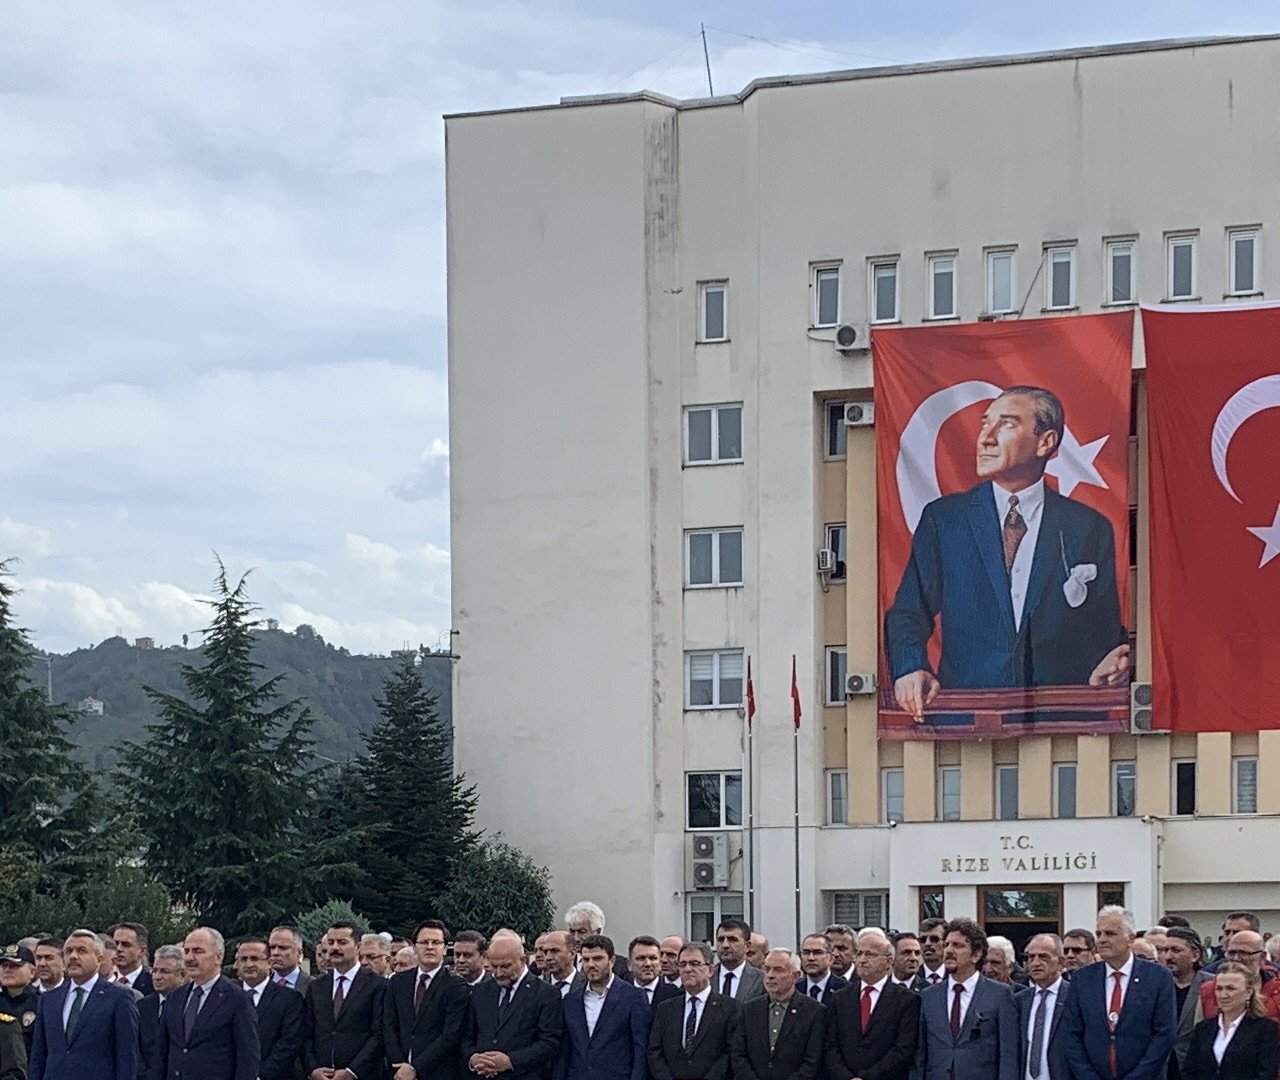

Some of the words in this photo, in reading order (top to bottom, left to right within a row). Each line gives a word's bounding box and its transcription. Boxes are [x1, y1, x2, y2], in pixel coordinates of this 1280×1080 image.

[999, 836, 1034, 850] T.C.
[941, 854, 989, 872] RİZE
[1002, 851, 1098, 872] VALİLİĞİ
